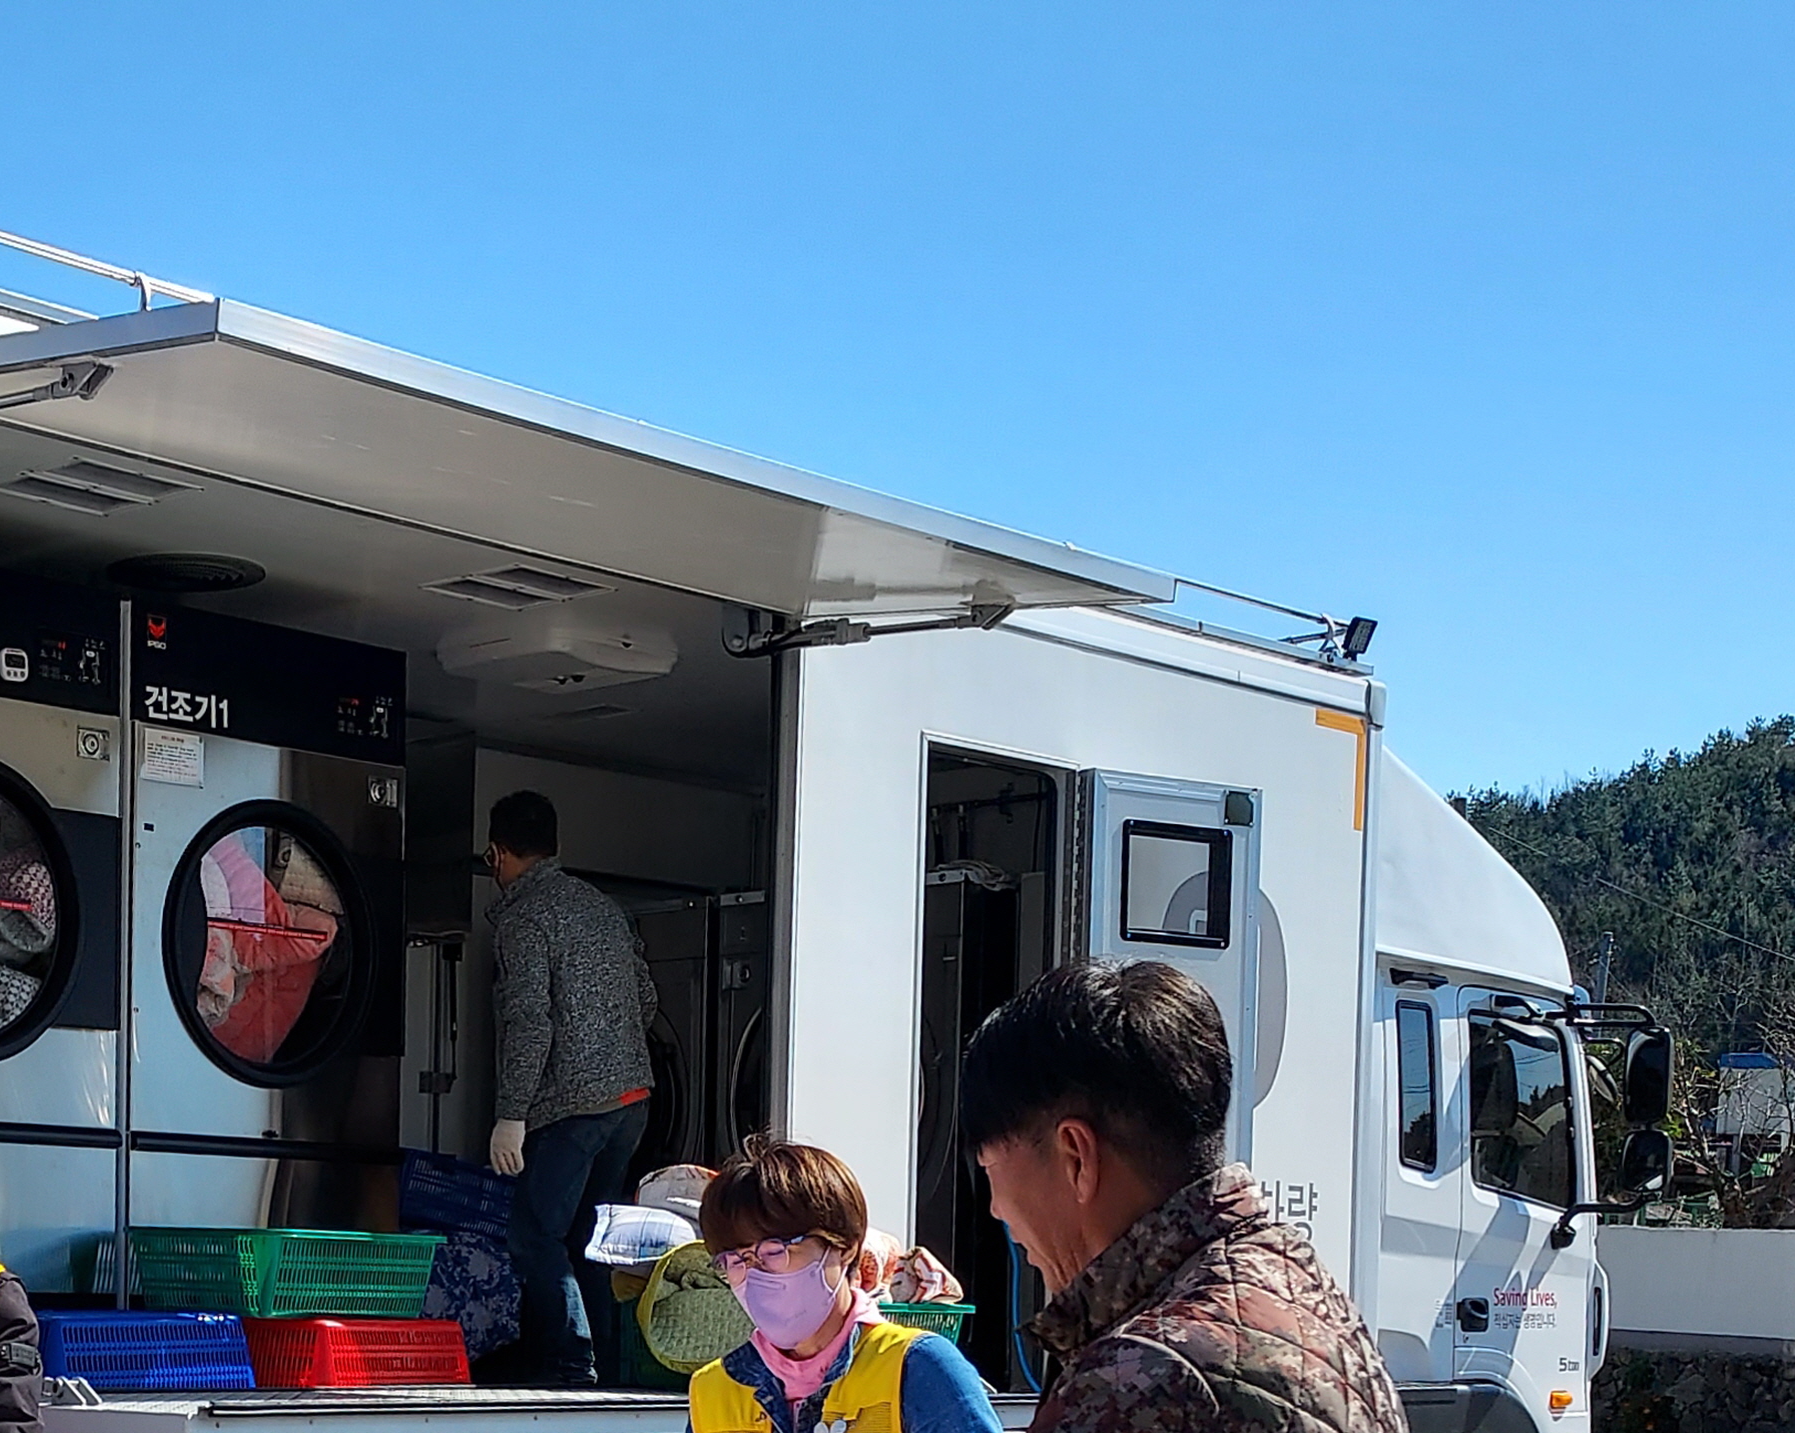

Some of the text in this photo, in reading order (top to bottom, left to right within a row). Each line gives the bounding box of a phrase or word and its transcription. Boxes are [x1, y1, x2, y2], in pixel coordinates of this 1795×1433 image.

[144, 685, 229, 729] 건조기1
[1493, 1285, 1558, 1312] Saving Lives,
